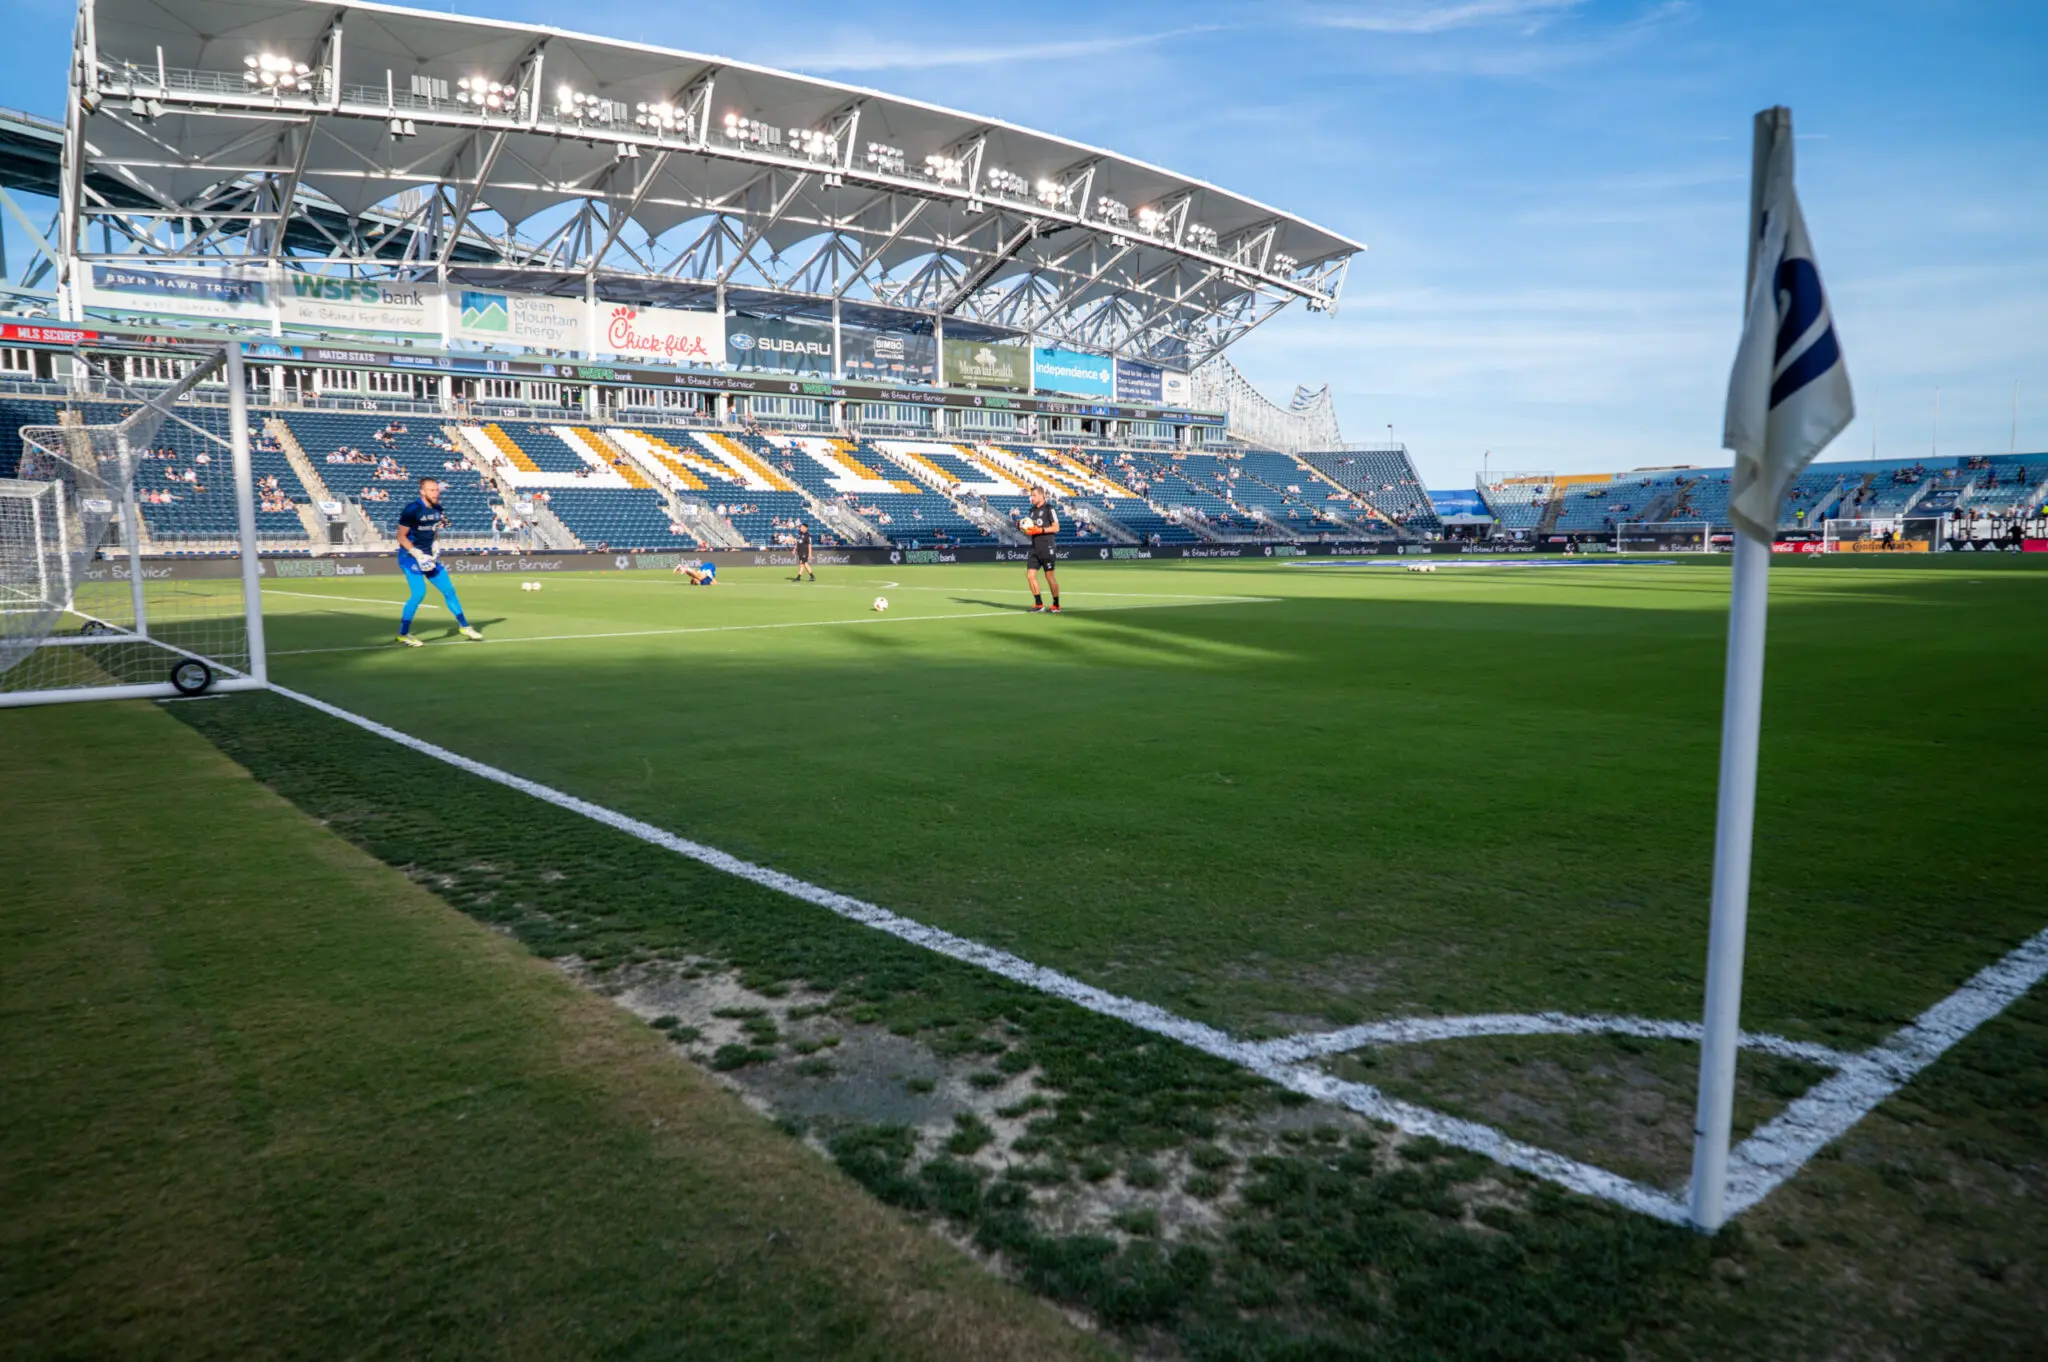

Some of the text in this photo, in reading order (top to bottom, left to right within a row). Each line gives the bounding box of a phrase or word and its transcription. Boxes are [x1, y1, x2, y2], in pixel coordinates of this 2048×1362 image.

[106, 273, 249, 295] BRYN MAWR TRUST
[292, 273, 423, 305] WSFS bank
[514, 297, 555, 312] Green
[299, 308, 423, 327] We Stand For Service
[514, 311, 578, 327] Mountain
[17, 327, 85, 340] MLS SCORES
[515, 323, 564, 340] Energy
[608, 315, 708, 356] Chick-fil-A
[758, 337, 832, 356] SUBARU
[876, 340, 902, 350] BIMBO
[319, 349, 376, 362] MATCH STATS
[487, 360, 494, 371] 0
[501, 361, 508, 372] 0
[1035, 361, 1098, 380] Independence
[577, 366, 633, 382] WSFS bank
[675, 375, 755, 389] We Stand For Service
[831, 388, 847, 396] bank
[362, 401, 377, 410] 124
[503, 409, 515, 417] 125
[458, 422, 1141, 499] UNION
[636, 554, 681, 569] WSFS
[754, 553, 850, 565] We Stand Service
[906, 550, 957, 563] WSFS bank
[996, 550, 1006, 560] We
[1008, 550, 1028, 560] Stand
[1138, 550, 1152, 559] bank
[111, 564, 173, 579] Sevice
[274, 559, 365, 577] WSFS bank
[456, 559, 491, 572] Stand
[496, 560, 514, 570] For
[519, 558, 563, 570] Service
